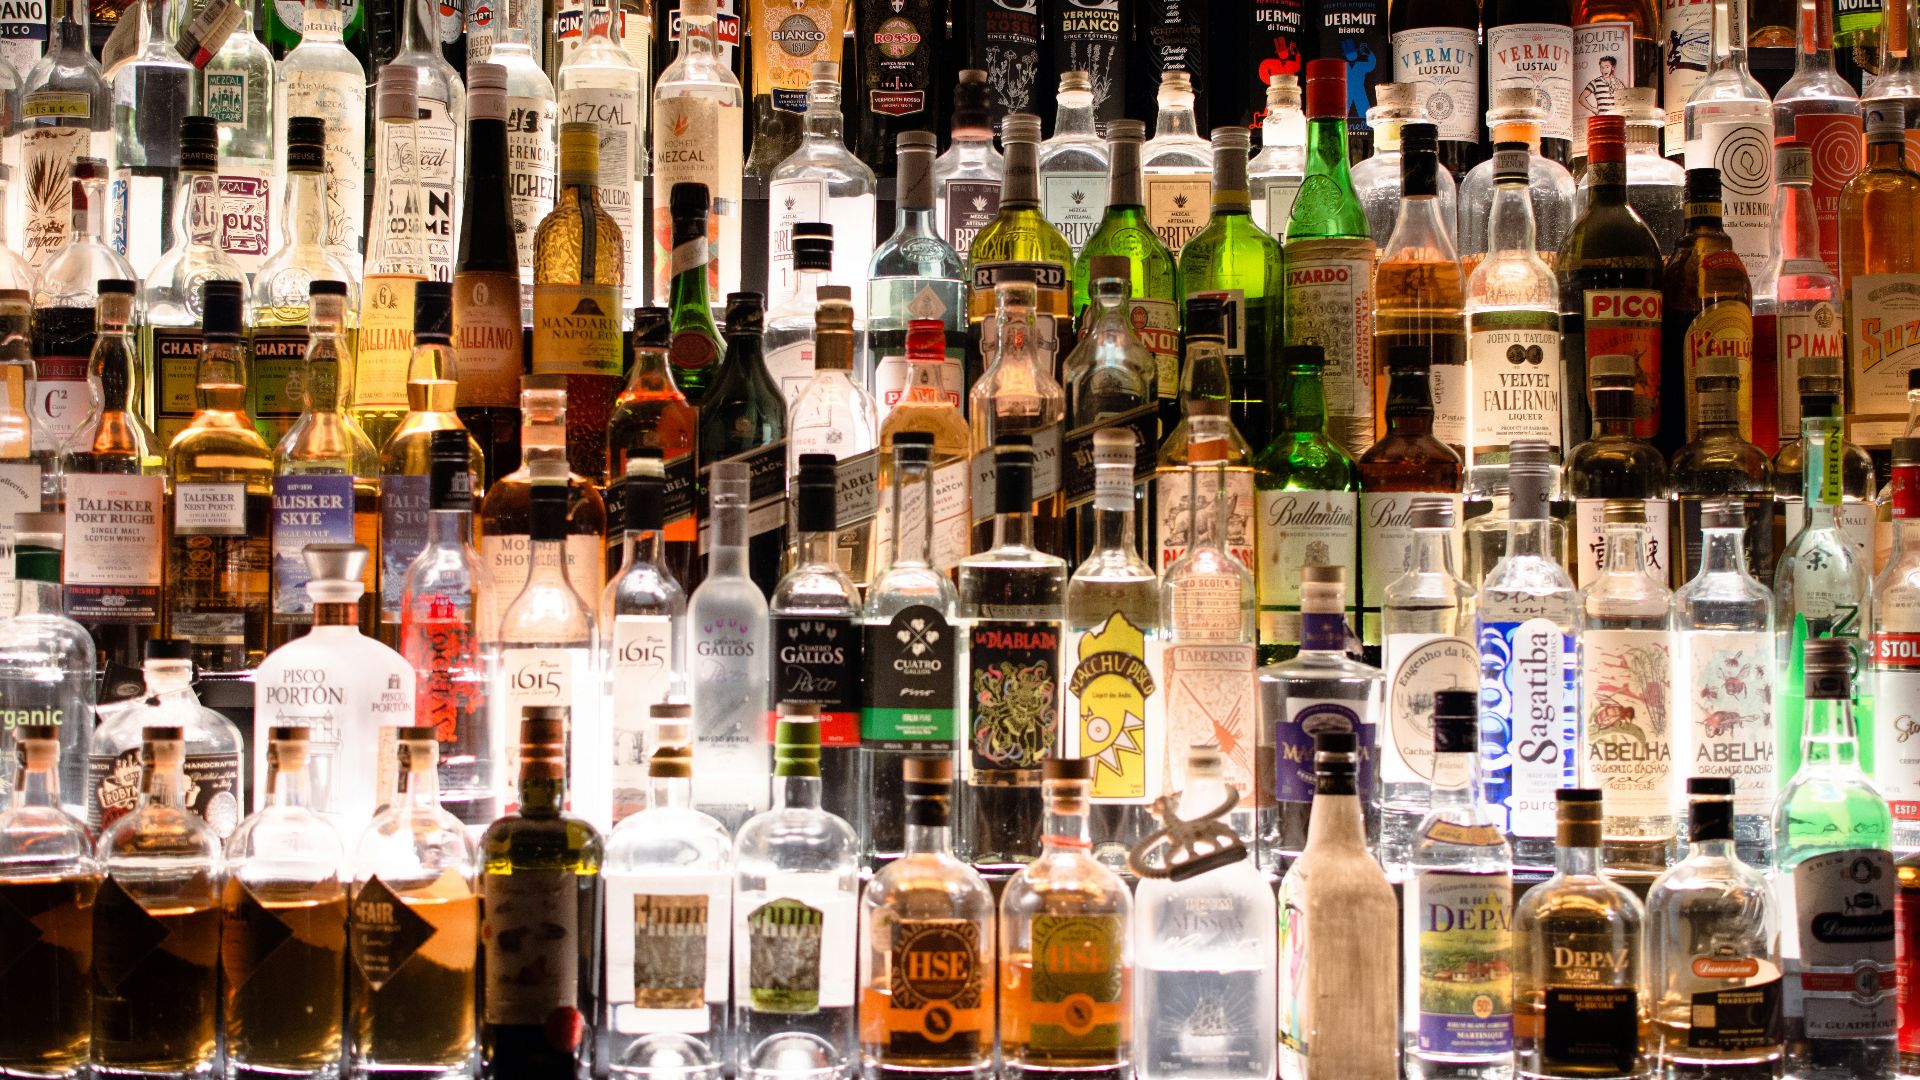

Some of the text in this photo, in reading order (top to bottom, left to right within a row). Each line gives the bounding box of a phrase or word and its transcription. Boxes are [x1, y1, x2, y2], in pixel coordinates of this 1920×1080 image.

[0, 1, 43, 20] ANO
[1838, 0, 1882, 11] NOILL
[1063, 11, 1120, 21] VERMOUTH
[1257, 9, 1301, 26] VERMUT
[1324, 12, 1377, 27] VERMUT
[1062, 19, 1119, 32] BIANCO
[1338, 26, 1365, 34] bianco
[772, 31, 826, 41] BIANCO
[875, 32, 922, 44] ROSSO
[1084, 33, 1118, 41] YESTERDAY
[1573, 30, 1626, 46] MOUTH
[1401, 47, 1474, 70] VERMUT
[1497, 43, 1571, 67] VERMUT
[1418, 65, 1460, 76] LUSTAU
[1516, 61, 1558, 73] LUSTAU
[210, 77, 242, 87] MEZCAL
[562, 103, 631, 126] MEZCAL
[510, 145, 551, 163] ERENCIA
[658, 150, 705, 163] MEZCAL
[515, 161, 526, 171] DE
[977, 268, 1061, 286] RIRD
[1286, 268, 1349, 287] UXARDO
[1591, 294, 1663, 320] PICO
[541, 317, 622, 330] MANDARIN
[1142, 333, 1179, 353] NOD
[1354, 296, 1364, 380] MARASCHINO
[1361, 289, 1370, 387] ORIGINALE
[1486, 332, 1508, 346] JOHN
[1861, 317, 1920, 373] SUZ
[1498, 373, 1551, 388] VELVET
[1483, 389, 1559, 412] FALERNUM
[1508, 413, 1543, 422] LIQUEUR
[751, 461, 783, 478] LACK
[1828, 425, 1841, 499] LEBLON
[836, 472, 878, 495] ABEL
[935, 481, 964, 496] BATCH
[77, 497, 153, 513] TALISKER
[183, 492, 235, 502] TALISKER
[386, 492, 430, 510] TALIS
[183, 503, 205, 511] NEIST
[74, 513, 156, 525] PORT RUIGHE
[280, 511, 322, 526] SKYE
[394, 511, 428, 524] STO
[1845, 517, 1867, 526] MALT
[84, 535, 147, 543] SCOTCH WHISKY
[91, 527, 140, 535] SINGLE MALT
[617, 641, 664, 667] 1615
[696, 641, 754, 657] GALLOS
[780, 646, 845, 665] GALLOS
[798, 644, 832, 652] CUATRO
[1880, 639, 1920, 659] STOL
[893, 658, 942, 671] CUATRO
[1398, 646, 1458, 688] Engenho da
[282, 669, 326, 684] PISCO
[510, 668, 562, 698] 1615
[785, 665, 836, 692] Pisco
[1070, 654, 1155, 696] MACCHU PISCO
[266, 683, 344, 707] PORTÓN
[381, 692, 408, 702] PISCO
[1520, 632, 1558, 765] Sagatiba
[1588, 741, 1672, 763] ABELHA
[1695, 741, 1775, 763] ABELHA
[1698, 765, 1743, 775] ORGANIC
[1428, 903, 1512, 933] DEPA
[908, 951, 968, 981] HSE
[1554, 946, 1630, 970] DEPAZ
[1456, 1031, 1505, 1040] MARTINIQUE
